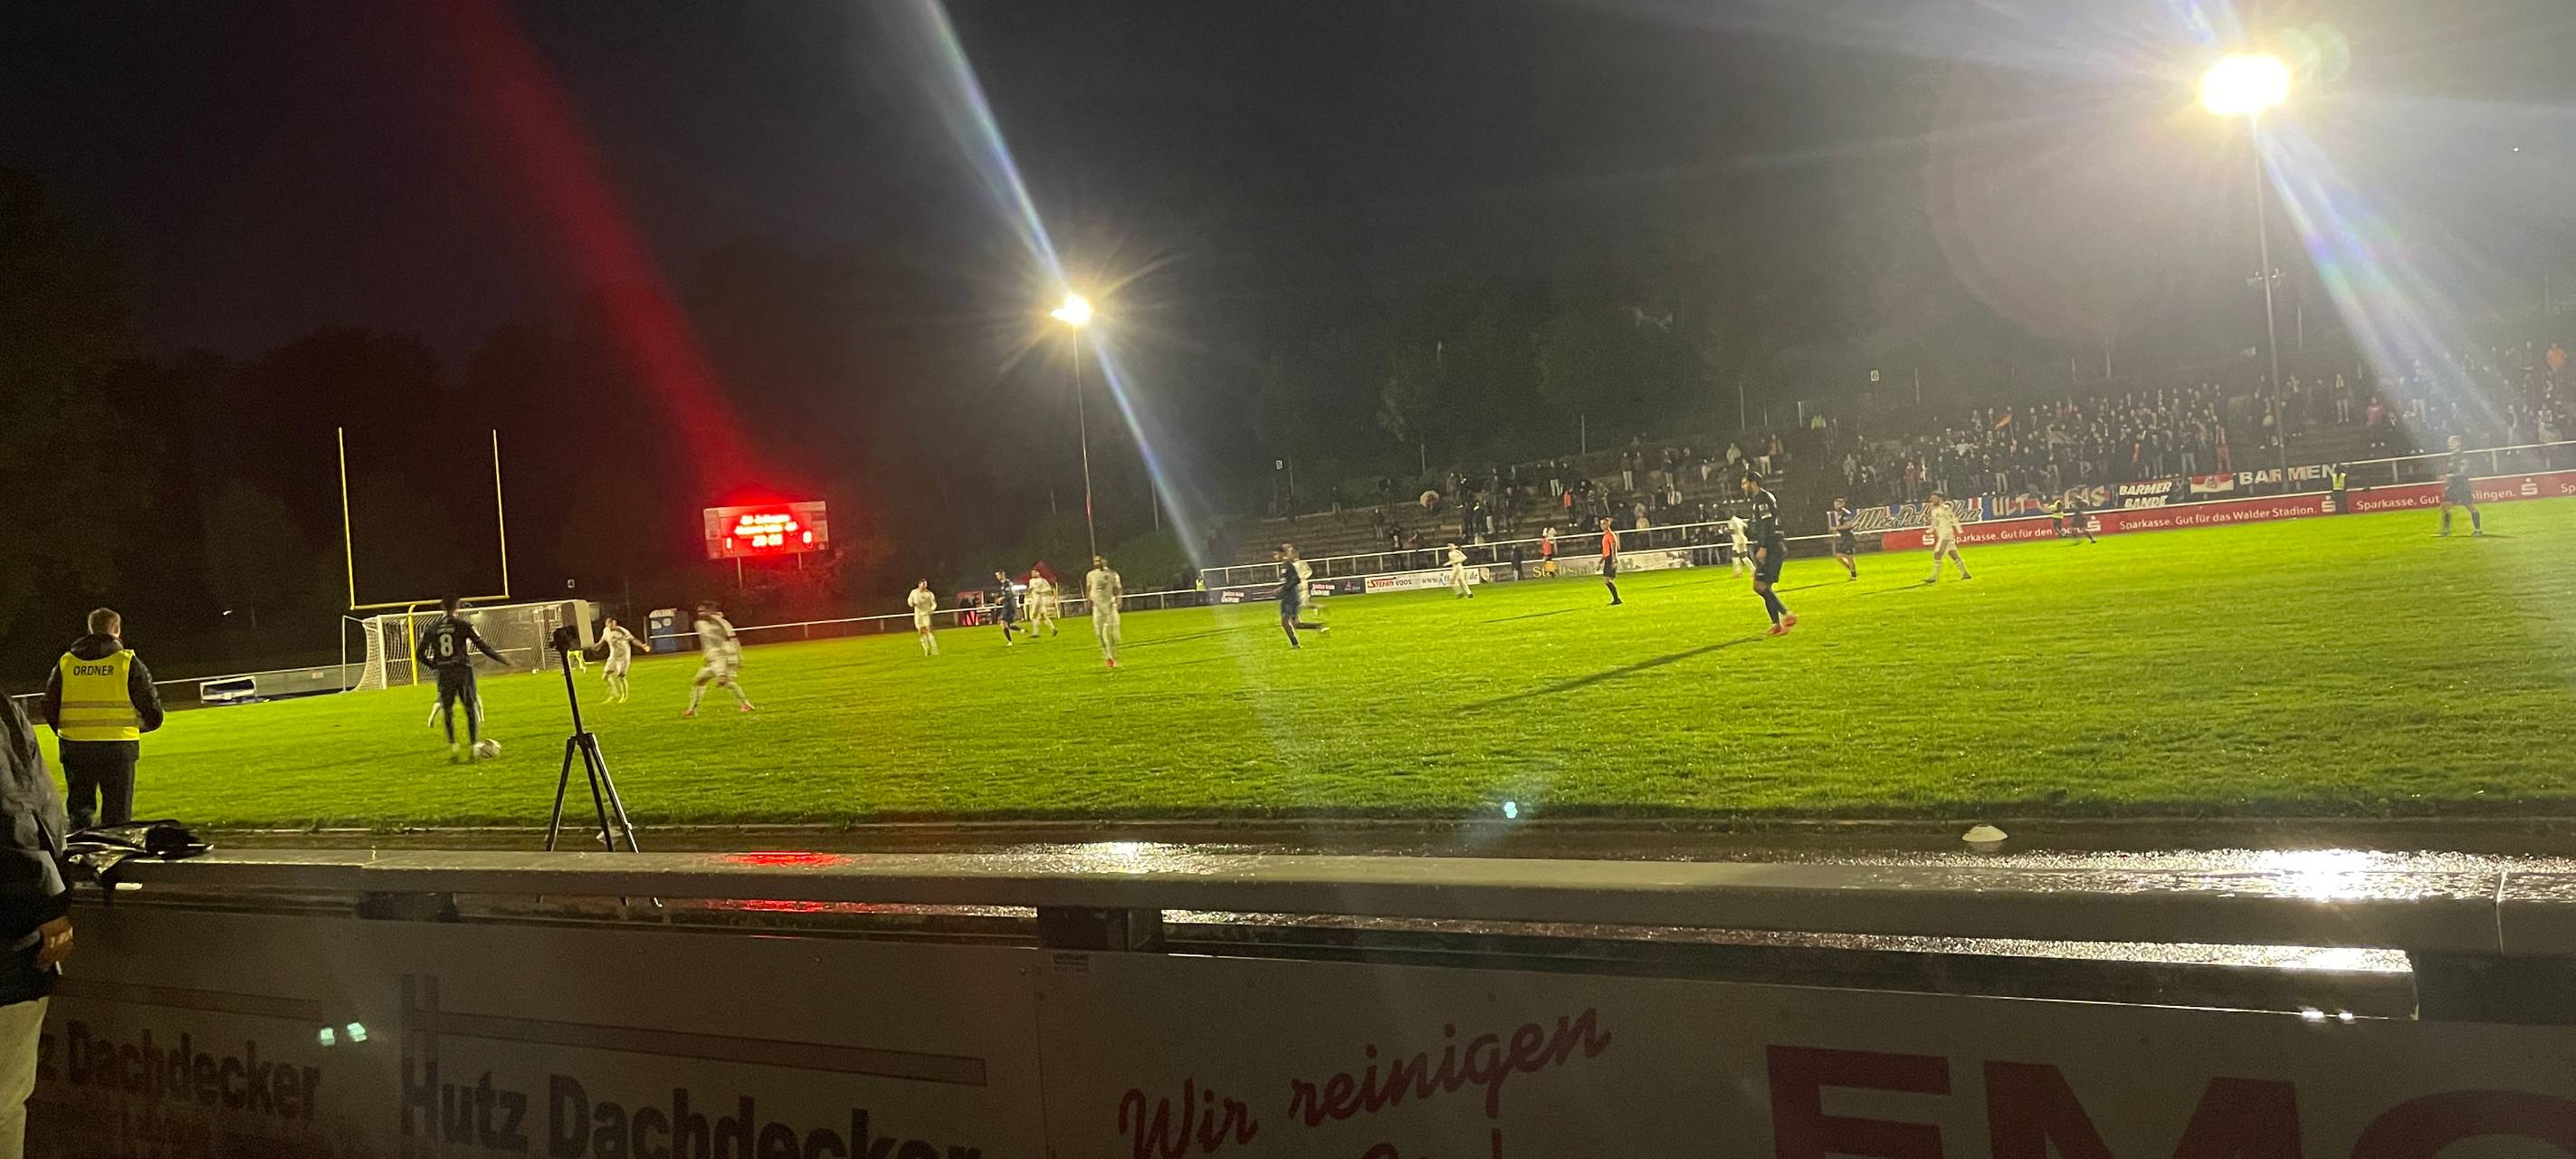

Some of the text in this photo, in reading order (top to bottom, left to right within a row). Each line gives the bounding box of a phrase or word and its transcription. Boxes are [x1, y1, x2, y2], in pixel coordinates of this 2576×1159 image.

[2119, 481, 2172, 495] BARMER
[2124, 495, 2168, 508] BANDE
[2356, 496, 2418, 511] Sparkasse.
[2419, 494, 2440, 505] Gut
[2175, 515, 2193, 525] Gut
[2195, 513, 2210, 523] für
[2212, 512, 2231, 522] das
[2232, 509, 2270, 520] Walder
[2272, 506, 2317, 517] Stadion.
[2000, 531, 2018, 541] Gut
[2019, 528, 2033, 539] für
[2034, 528, 2053, 537] den
[440, 634, 453, 656] 8
[72, 665, 114, 676] ORDNER
[67, 1019, 321, 1122] Dachdecker
[1119, 1007, 1612, 1159] Wir reinigen
[400, 1056, 530, 1152] Hutz
